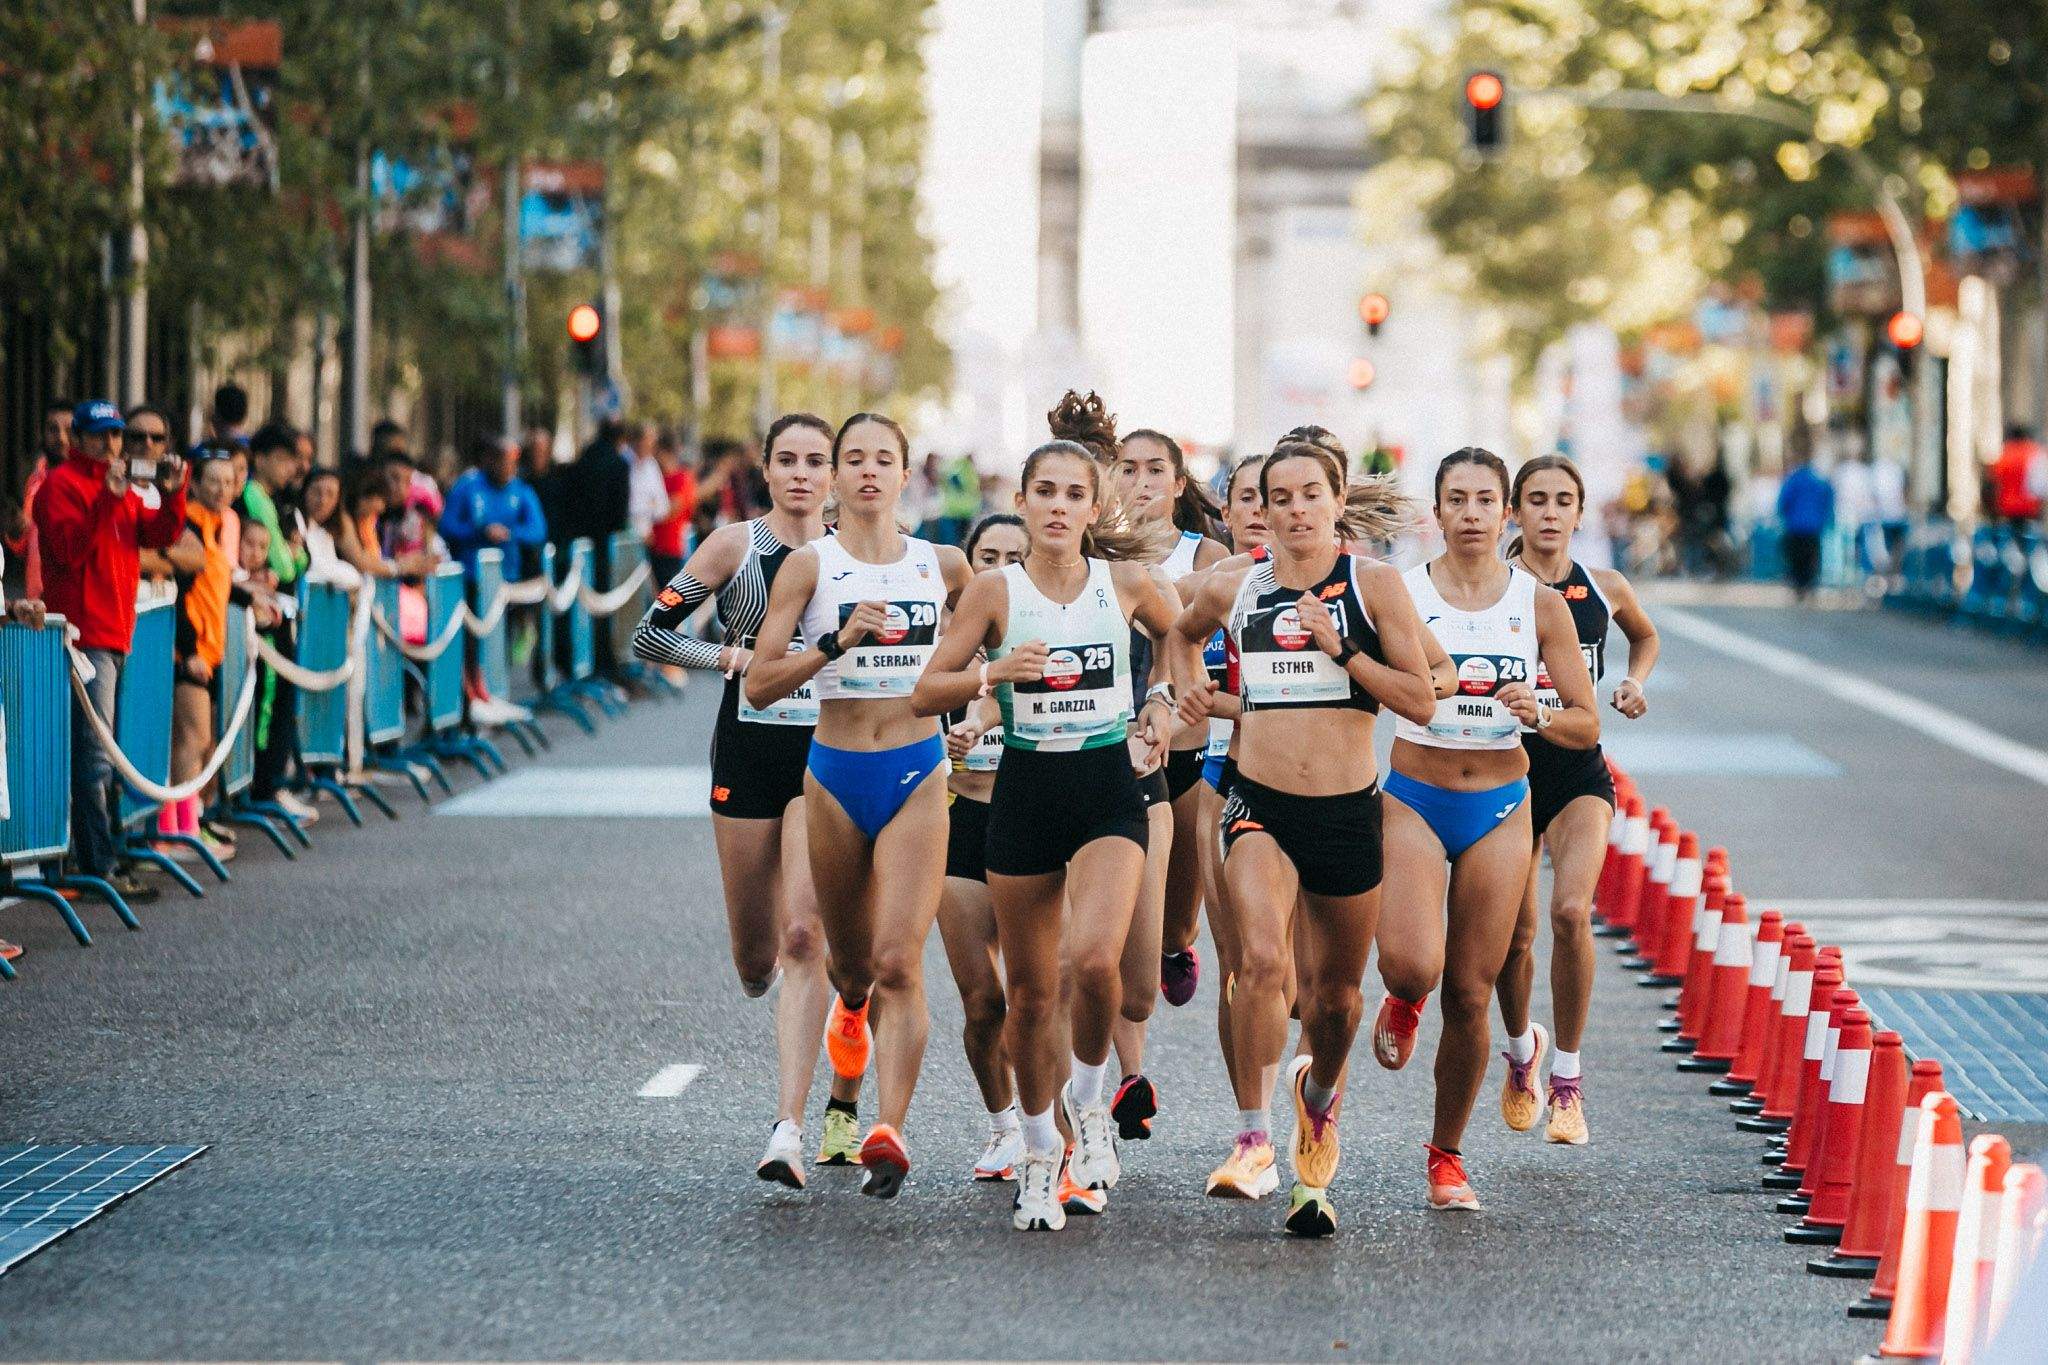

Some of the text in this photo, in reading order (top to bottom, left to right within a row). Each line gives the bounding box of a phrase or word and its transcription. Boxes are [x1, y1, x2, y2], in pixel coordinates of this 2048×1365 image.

[910, 603, 936, 627] 20
[856, 653, 922, 668] M. SERRANO
[1083, 646, 1112, 671] 25
[1271, 660, 1315, 674] ESTHER
[1499, 657, 1526, 681] 24
[1033, 698, 1096, 715] M. GARZZIA
[1457, 702, 1494, 718] MARÍA
